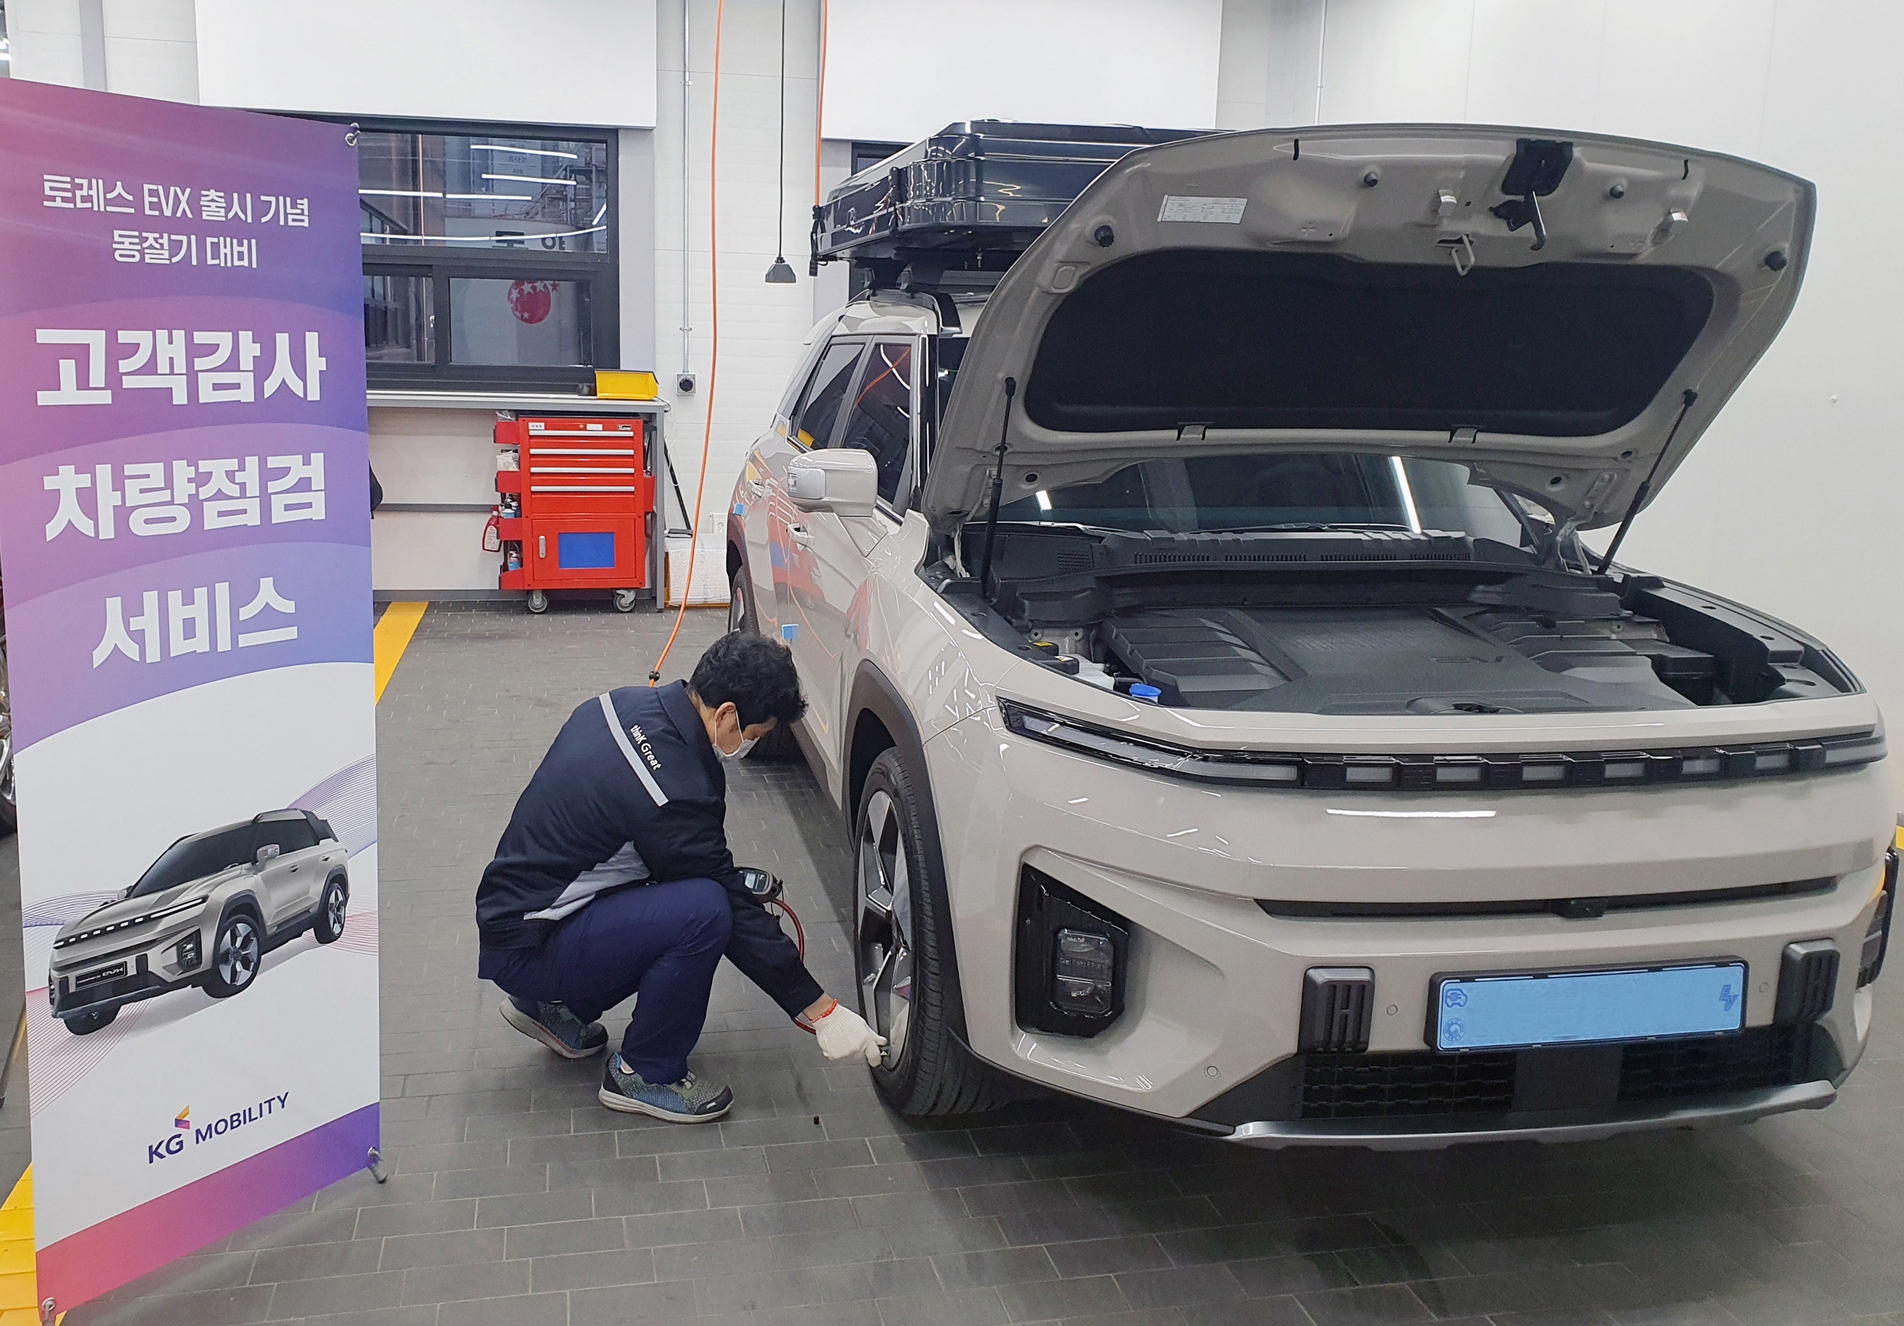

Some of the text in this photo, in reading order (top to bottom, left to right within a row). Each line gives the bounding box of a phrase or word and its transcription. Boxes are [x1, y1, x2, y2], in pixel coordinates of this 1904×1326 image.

[43, 174, 309, 227] 토레스 EVX 출시 기념
[112, 229, 257, 269] 동절기 대비
[35, 328, 327, 406] 고객감사
[43, 452, 326, 542] 차량점검
[92, 576, 298, 669] 서비스
[641, 743, 661, 770] Great
[148, 1091, 289, 1164] KG MOBILITY
